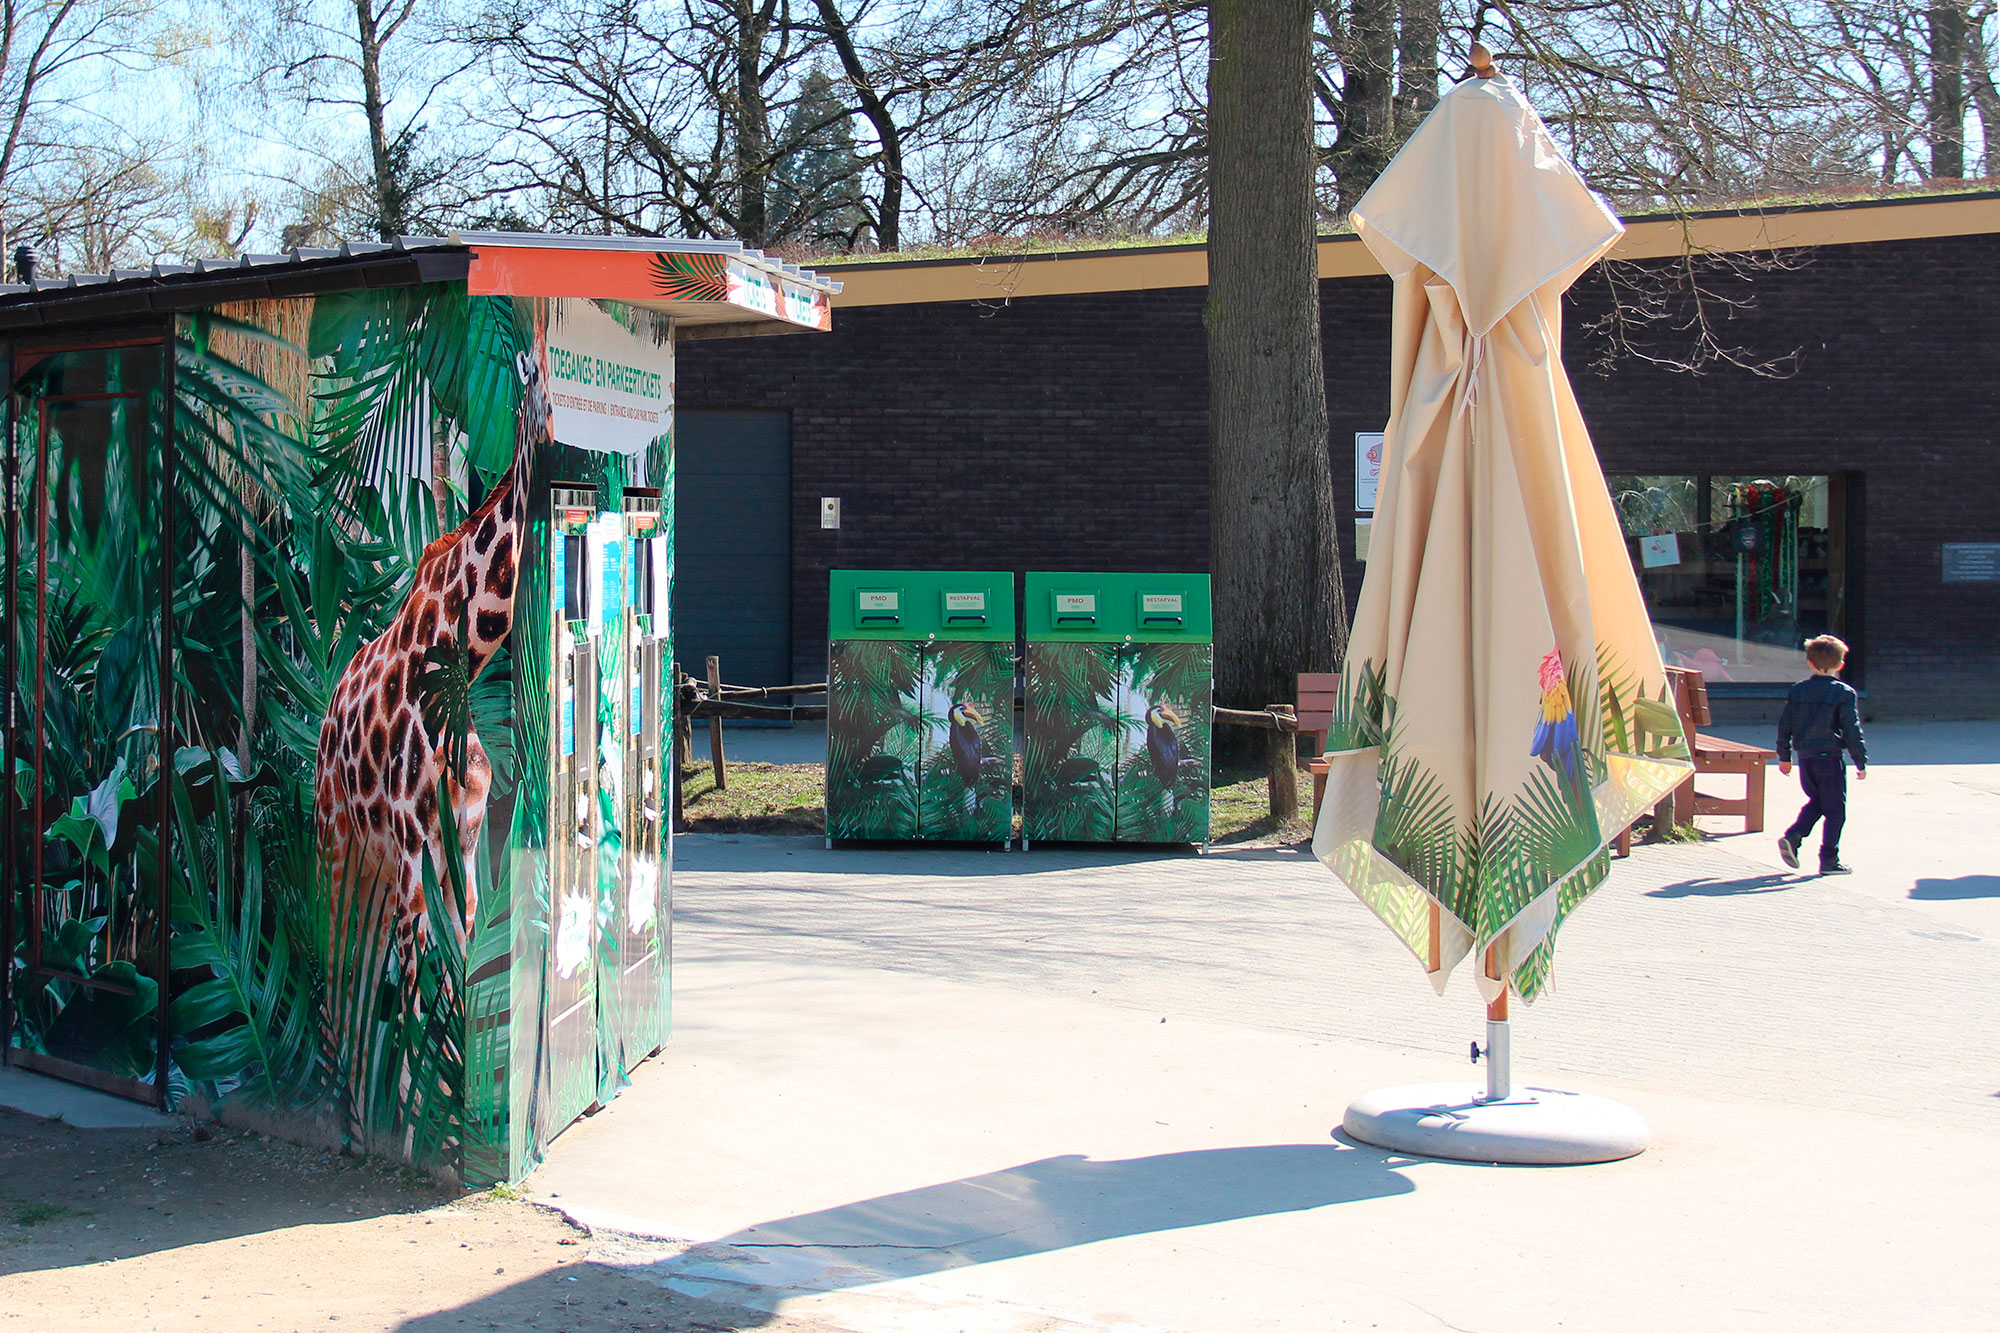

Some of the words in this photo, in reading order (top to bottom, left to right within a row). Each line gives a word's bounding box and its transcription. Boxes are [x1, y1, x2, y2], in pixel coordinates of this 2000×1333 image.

[549, 346, 594, 385] TOEGANGS-
[596, 358, 606, 389] EN
[608, 361, 661, 400] PARKEERTICKETS
